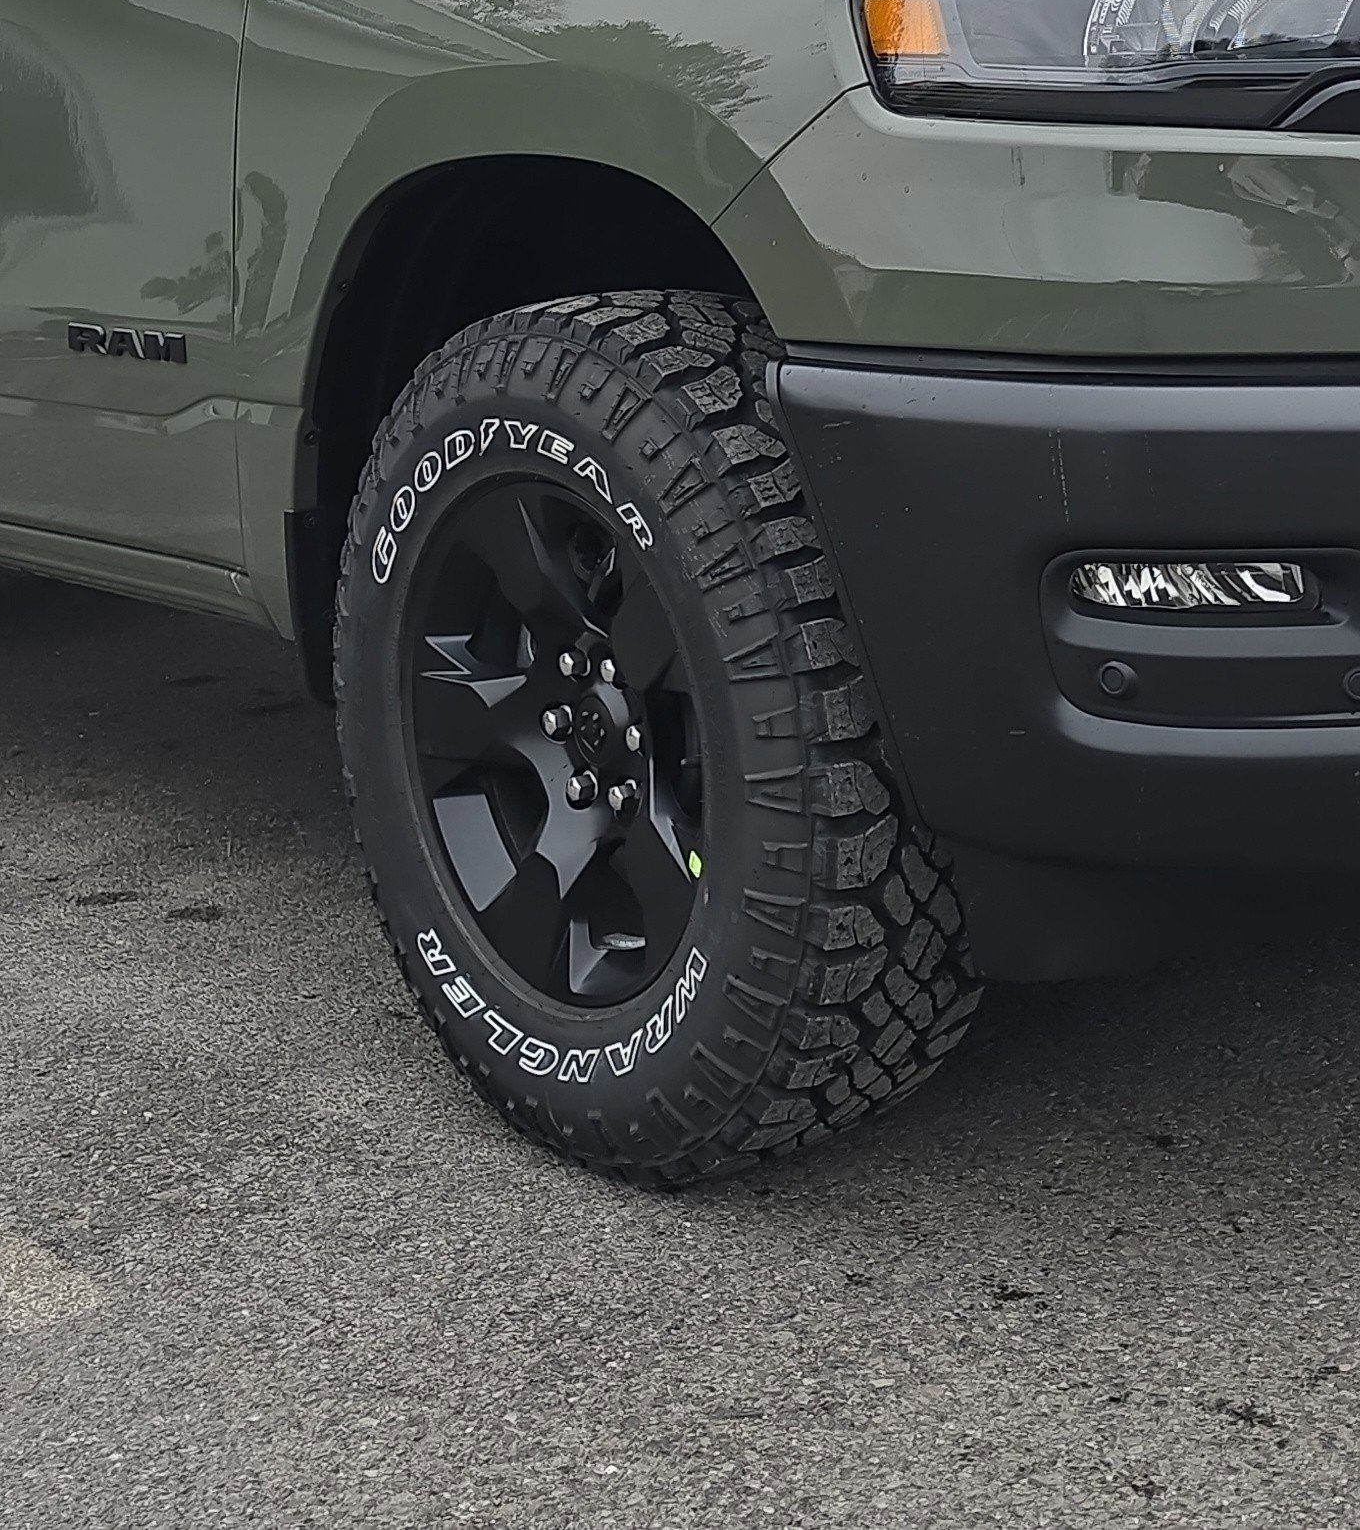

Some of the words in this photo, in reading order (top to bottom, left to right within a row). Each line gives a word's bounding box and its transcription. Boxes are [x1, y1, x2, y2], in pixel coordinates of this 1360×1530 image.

[68, 321, 187, 363] RAM
[372, 418, 654, 584] GOODYEAR
[416, 928, 708, 1083] WRANGLER
